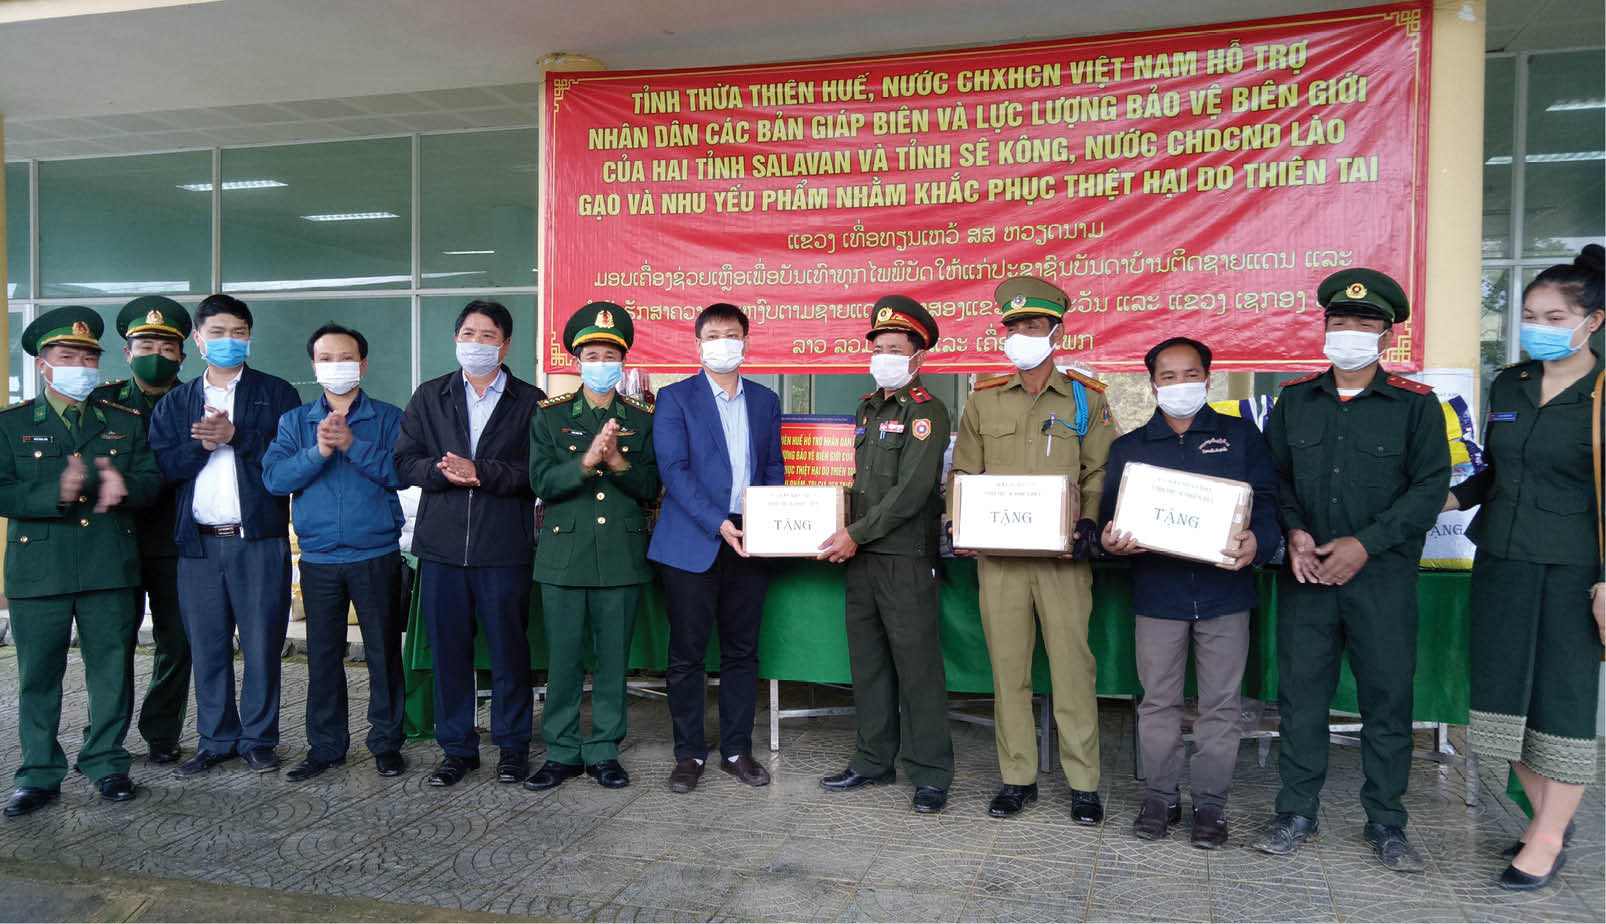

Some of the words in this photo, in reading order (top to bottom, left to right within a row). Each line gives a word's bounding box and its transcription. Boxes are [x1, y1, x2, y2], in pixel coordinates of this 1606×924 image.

[589, 123, 648, 150] NHÂN
[654, 120, 698, 147] DÂN
[706, 117, 750, 144] CÁC
[757, 111, 803, 142] BẢN
[811, 110, 865, 139] GIÁP
[873, 104, 928, 136] BIÊN
[937, 101, 968, 131] VÀ
[976, 101, 1023, 133] LỰC
[1032, 96, 1117, 128] LƯỢNG
[1127, 85, 1180, 120] BẢO
[1190, 84, 1222, 120] VỆ
[1232, 80, 1299, 112] BIÊN
[1308, 72, 1368, 106] GIỚI
[632, 85, 680, 114] TỈNH
[686, 84, 742, 111] THỪA
[749, 80, 814, 107] THIÊN
[822, 73, 874, 102] HUẾ,
[883, 70, 948, 97] NƯỚC
[957, 64, 1061, 93] CHXHCN
[1070, 56, 1124, 88] VIỆT
[1134, 51, 1197, 80] NAM
[1208, 40, 1243, 74] HỖ
[1253, 40, 1308, 73] TRỢ
[603, 154, 645, 184] CỦA
[652, 159, 688, 182] HAI
[696, 150, 745, 180] TỈNH
[752, 152, 850, 179] SALAVAN
[859, 144, 888, 172] VÀ
[896, 139, 951, 170] TỈNH
[960, 137, 989, 168] SÊ
[999, 136, 1076, 165] KÔNG,
[1085, 129, 1157, 160] NƯỚC
[1168, 123, 1281, 155] CHDCND
[1291, 115, 1344, 147] LÀO
[579, 194, 621, 220] GẠO
[628, 189, 654, 216] VÀ
[662, 192, 706, 216] NHU
[714, 187, 755, 213] YẾU
[762, 180, 828, 211] PHẨM
[836, 176, 907, 208] NHẰM
[915, 173, 980, 205] KHẮC
[988, 176, 1056, 206] PHỤC
[1064, 169, 1136, 200] THIỆT
[1143, 168, 1187, 198] HẠI
[1197, 165, 1234, 191] DO
[1243, 156, 1325, 189] THIÊN
[1336, 156, 1378, 182] TAI
